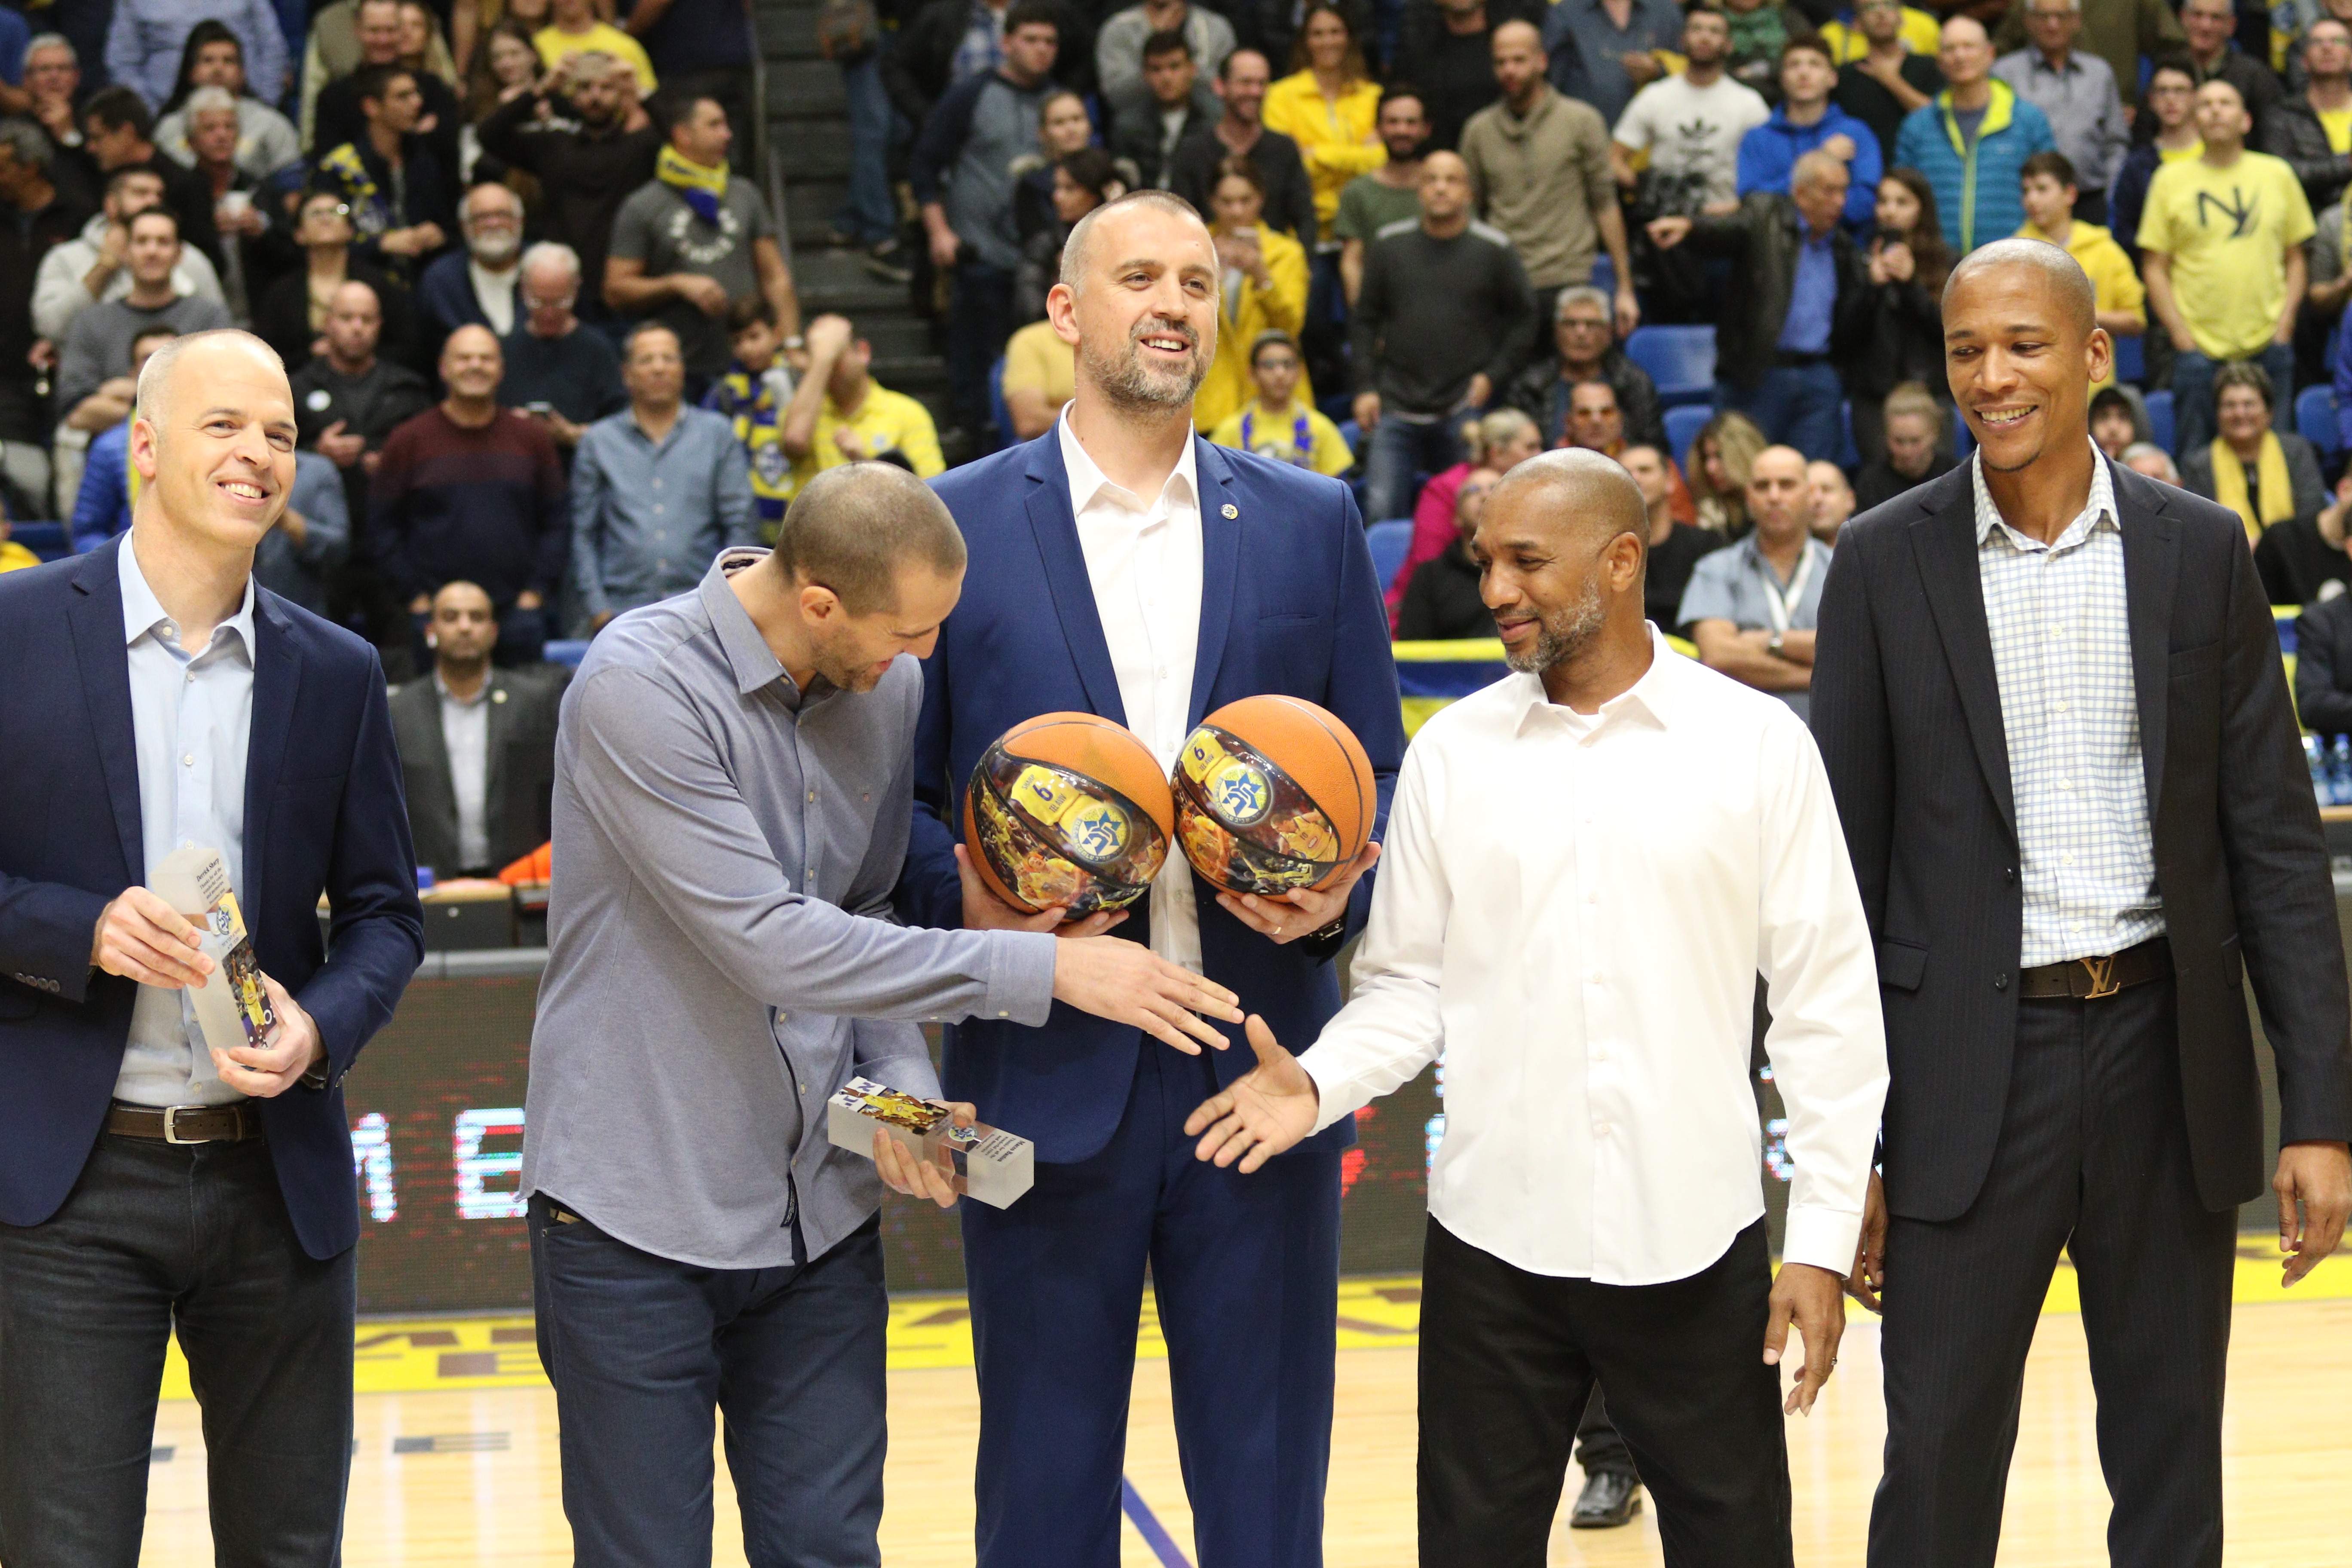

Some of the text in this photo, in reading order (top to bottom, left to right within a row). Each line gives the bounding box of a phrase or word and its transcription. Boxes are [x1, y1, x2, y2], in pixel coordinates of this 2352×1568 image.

[1194, 746, 1205, 761] 6
[1198, 753, 1215, 772] TEL AVIV
[1021, 773, 1035, 790] SHARP
[1032, 784, 1054, 802] 6
[1048, 793, 1067, 813] TEL AVIV
[196, 858, 220, 882] Derrick Sharp
